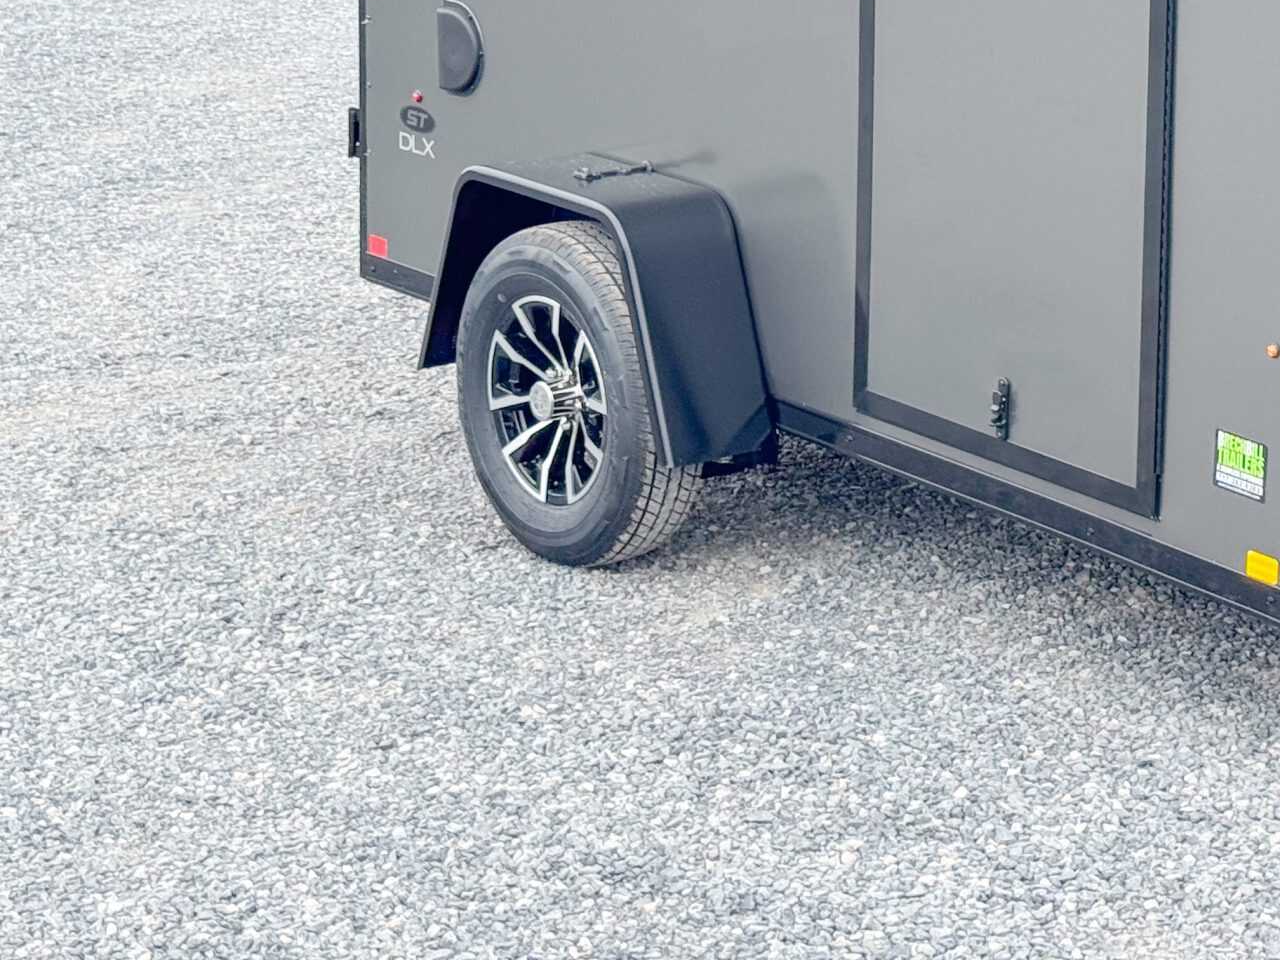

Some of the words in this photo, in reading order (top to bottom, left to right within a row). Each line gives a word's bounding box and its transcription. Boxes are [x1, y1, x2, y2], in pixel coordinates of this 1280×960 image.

[407, 109, 428, 128] ST
[399, 131, 436, 159] DLX
[1217, 446, 1265, 478] TRAILERS
